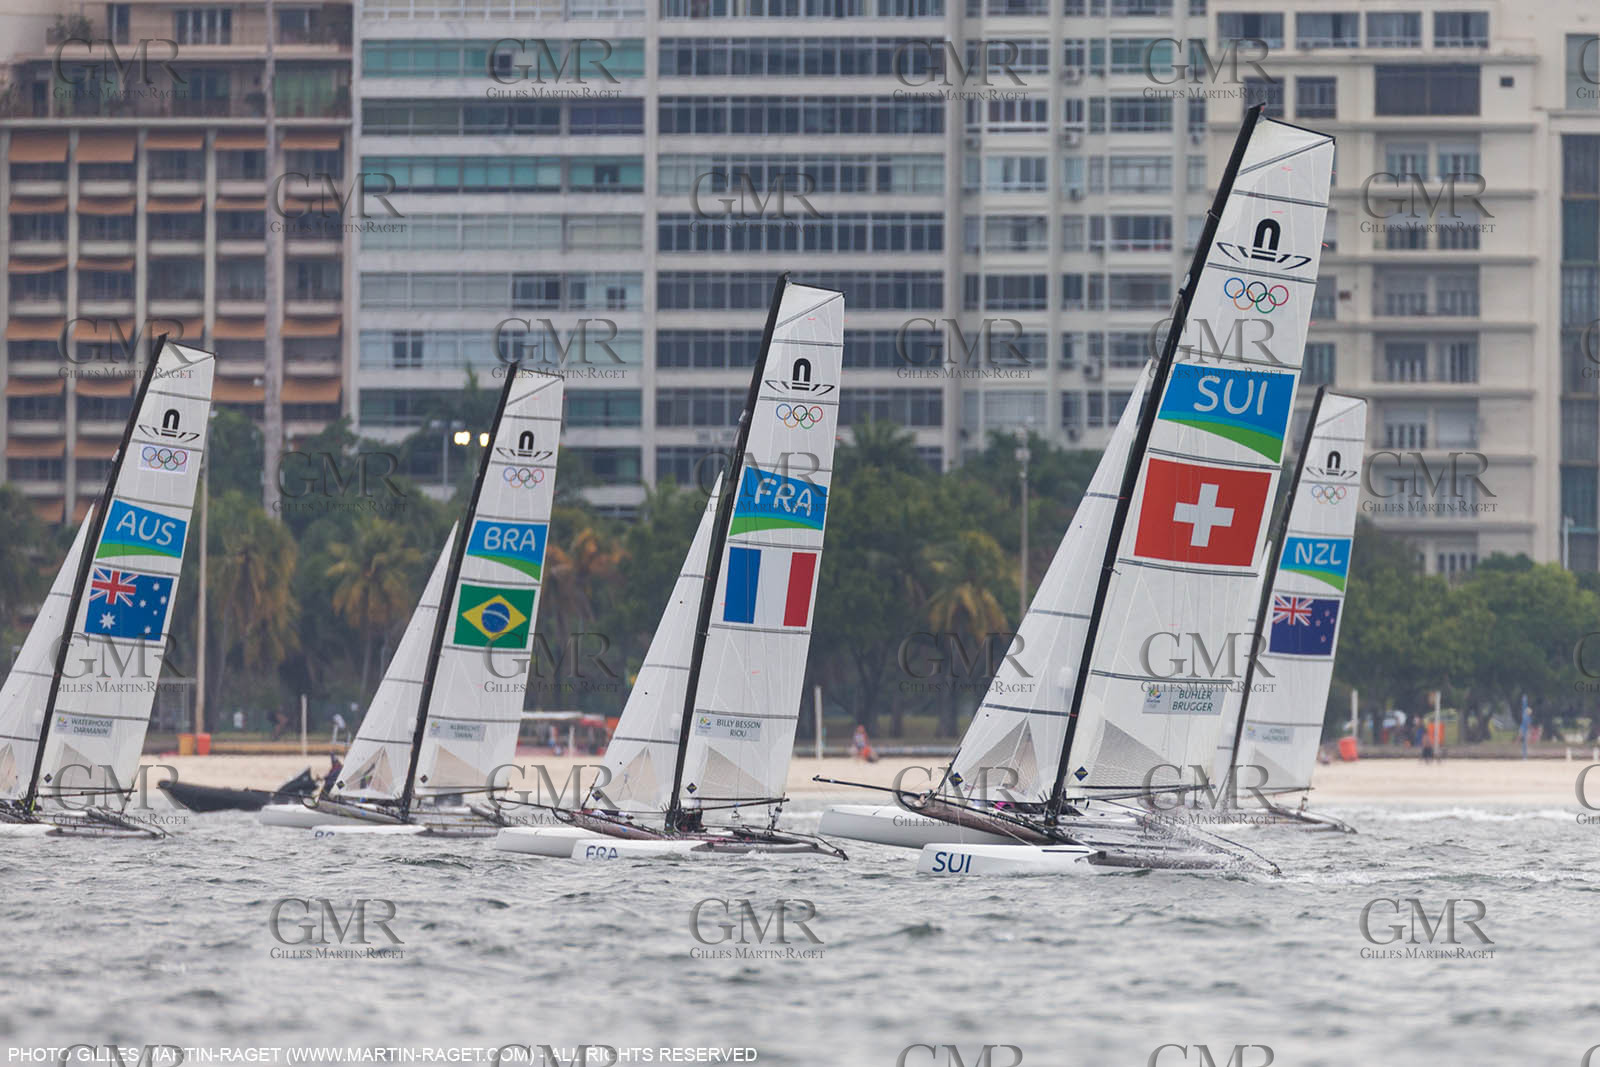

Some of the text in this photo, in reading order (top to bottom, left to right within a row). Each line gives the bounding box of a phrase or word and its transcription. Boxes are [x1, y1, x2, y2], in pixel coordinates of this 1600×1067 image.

[1193, 376, 1268, 415] SUI
[755, 477, 812, 517] FRA
[116, 510, 176, 546] AUS
[483, 526, 536, 552] BRA
[1295, 542, 1342, 566] NZL
[1172, 701, 1213, 712] BRUGGER
[716, 719, 735, 727] BILLY
[735, 720, 761, 729] BESSON
[730, 730, 747, 738] RIOU
[586, 845, 619, 860] FRA
[932, 851, 972, 873] SUI
